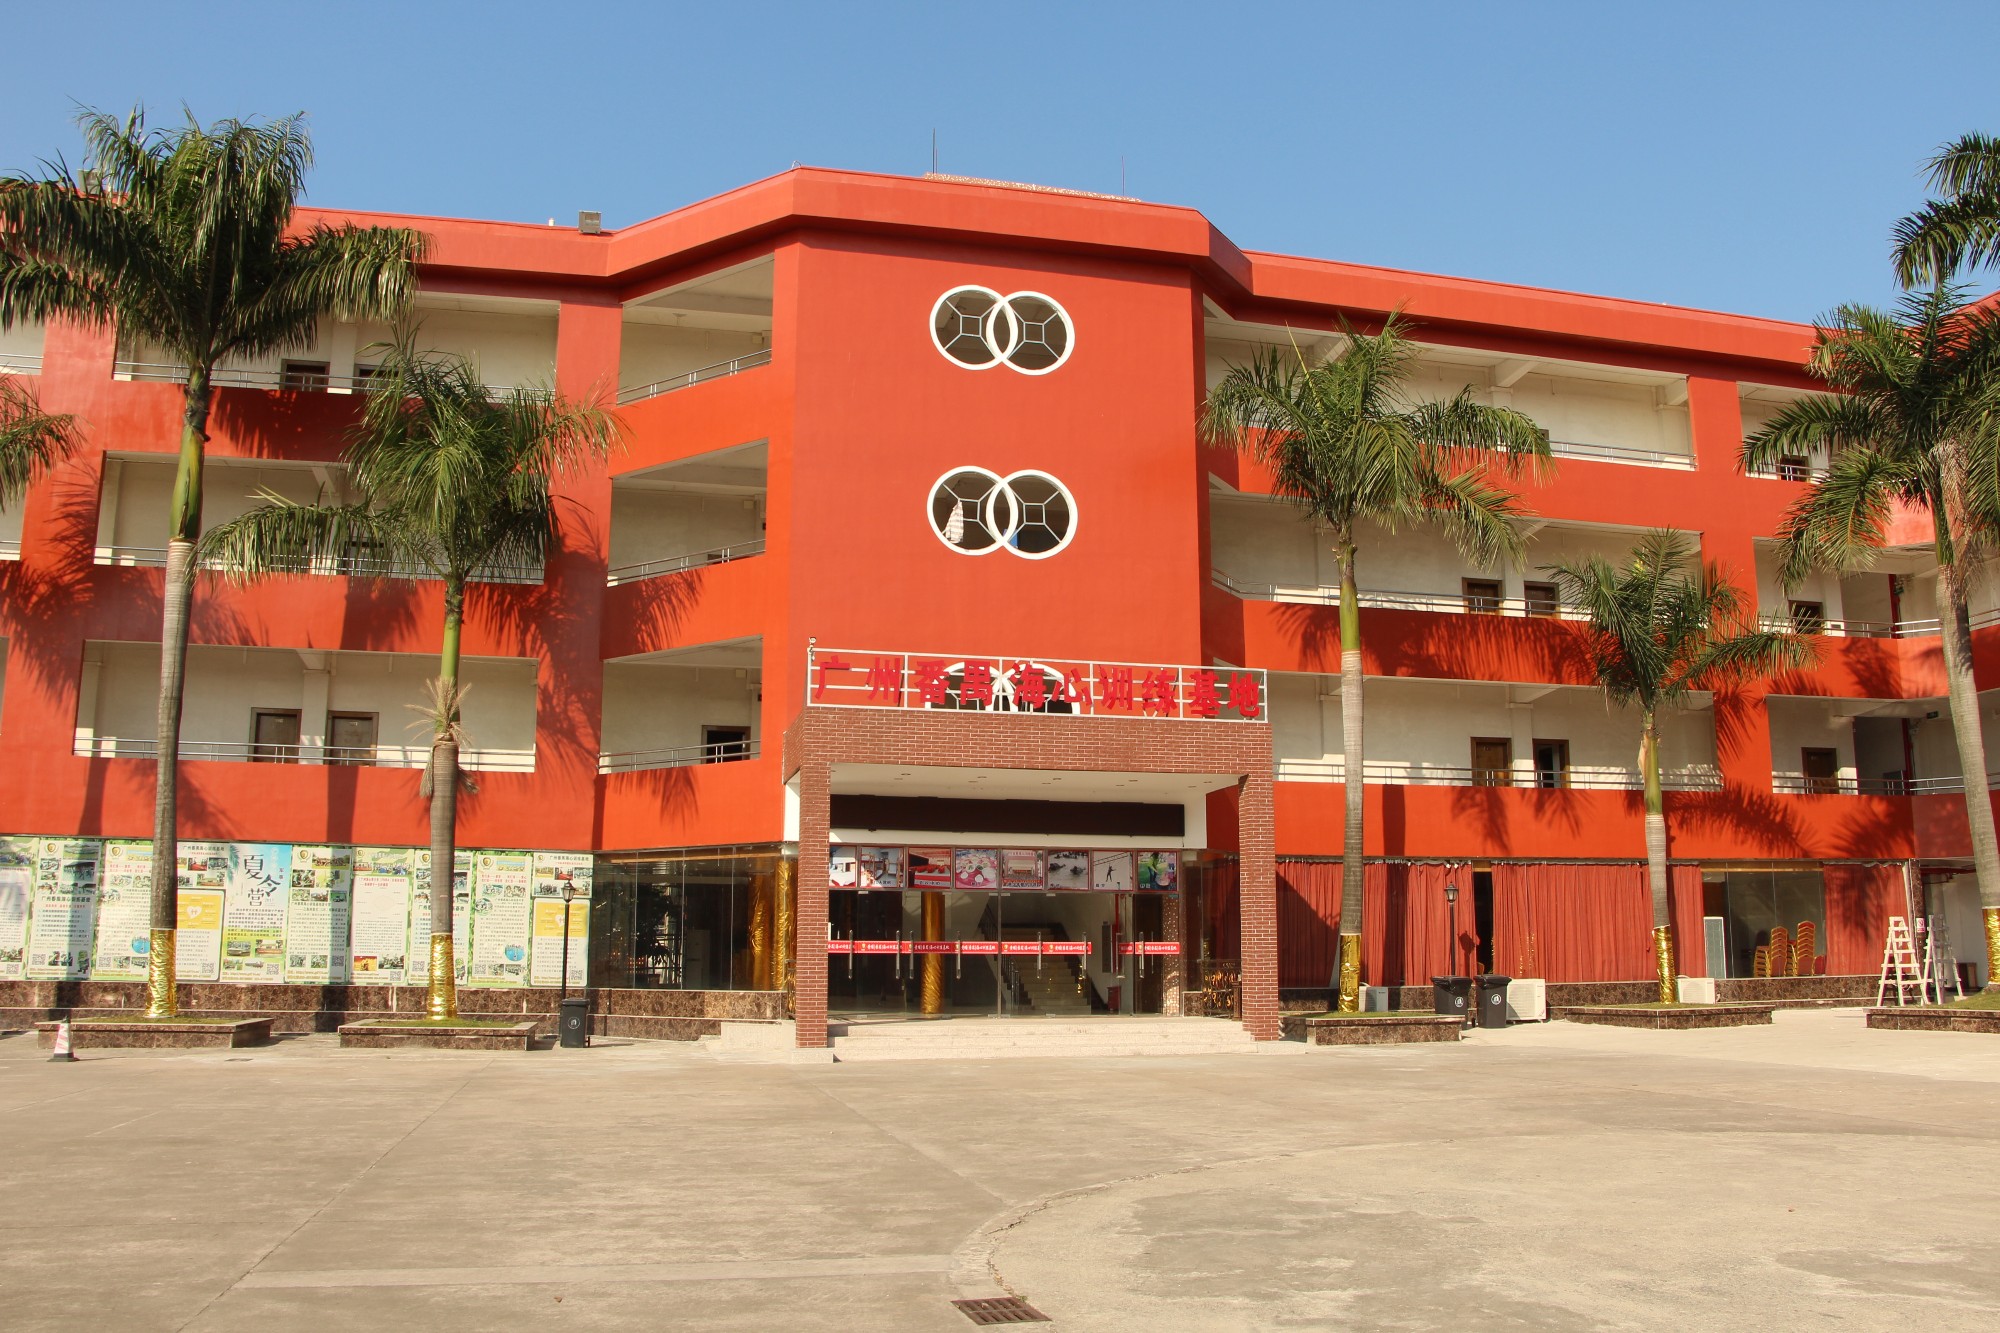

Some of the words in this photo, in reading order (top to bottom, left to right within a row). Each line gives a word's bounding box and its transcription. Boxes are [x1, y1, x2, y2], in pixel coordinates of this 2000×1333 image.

[814, 654, 1261, 718] 广州番禺海心训练基地
[243, 854, 281, 906] 夏令营
